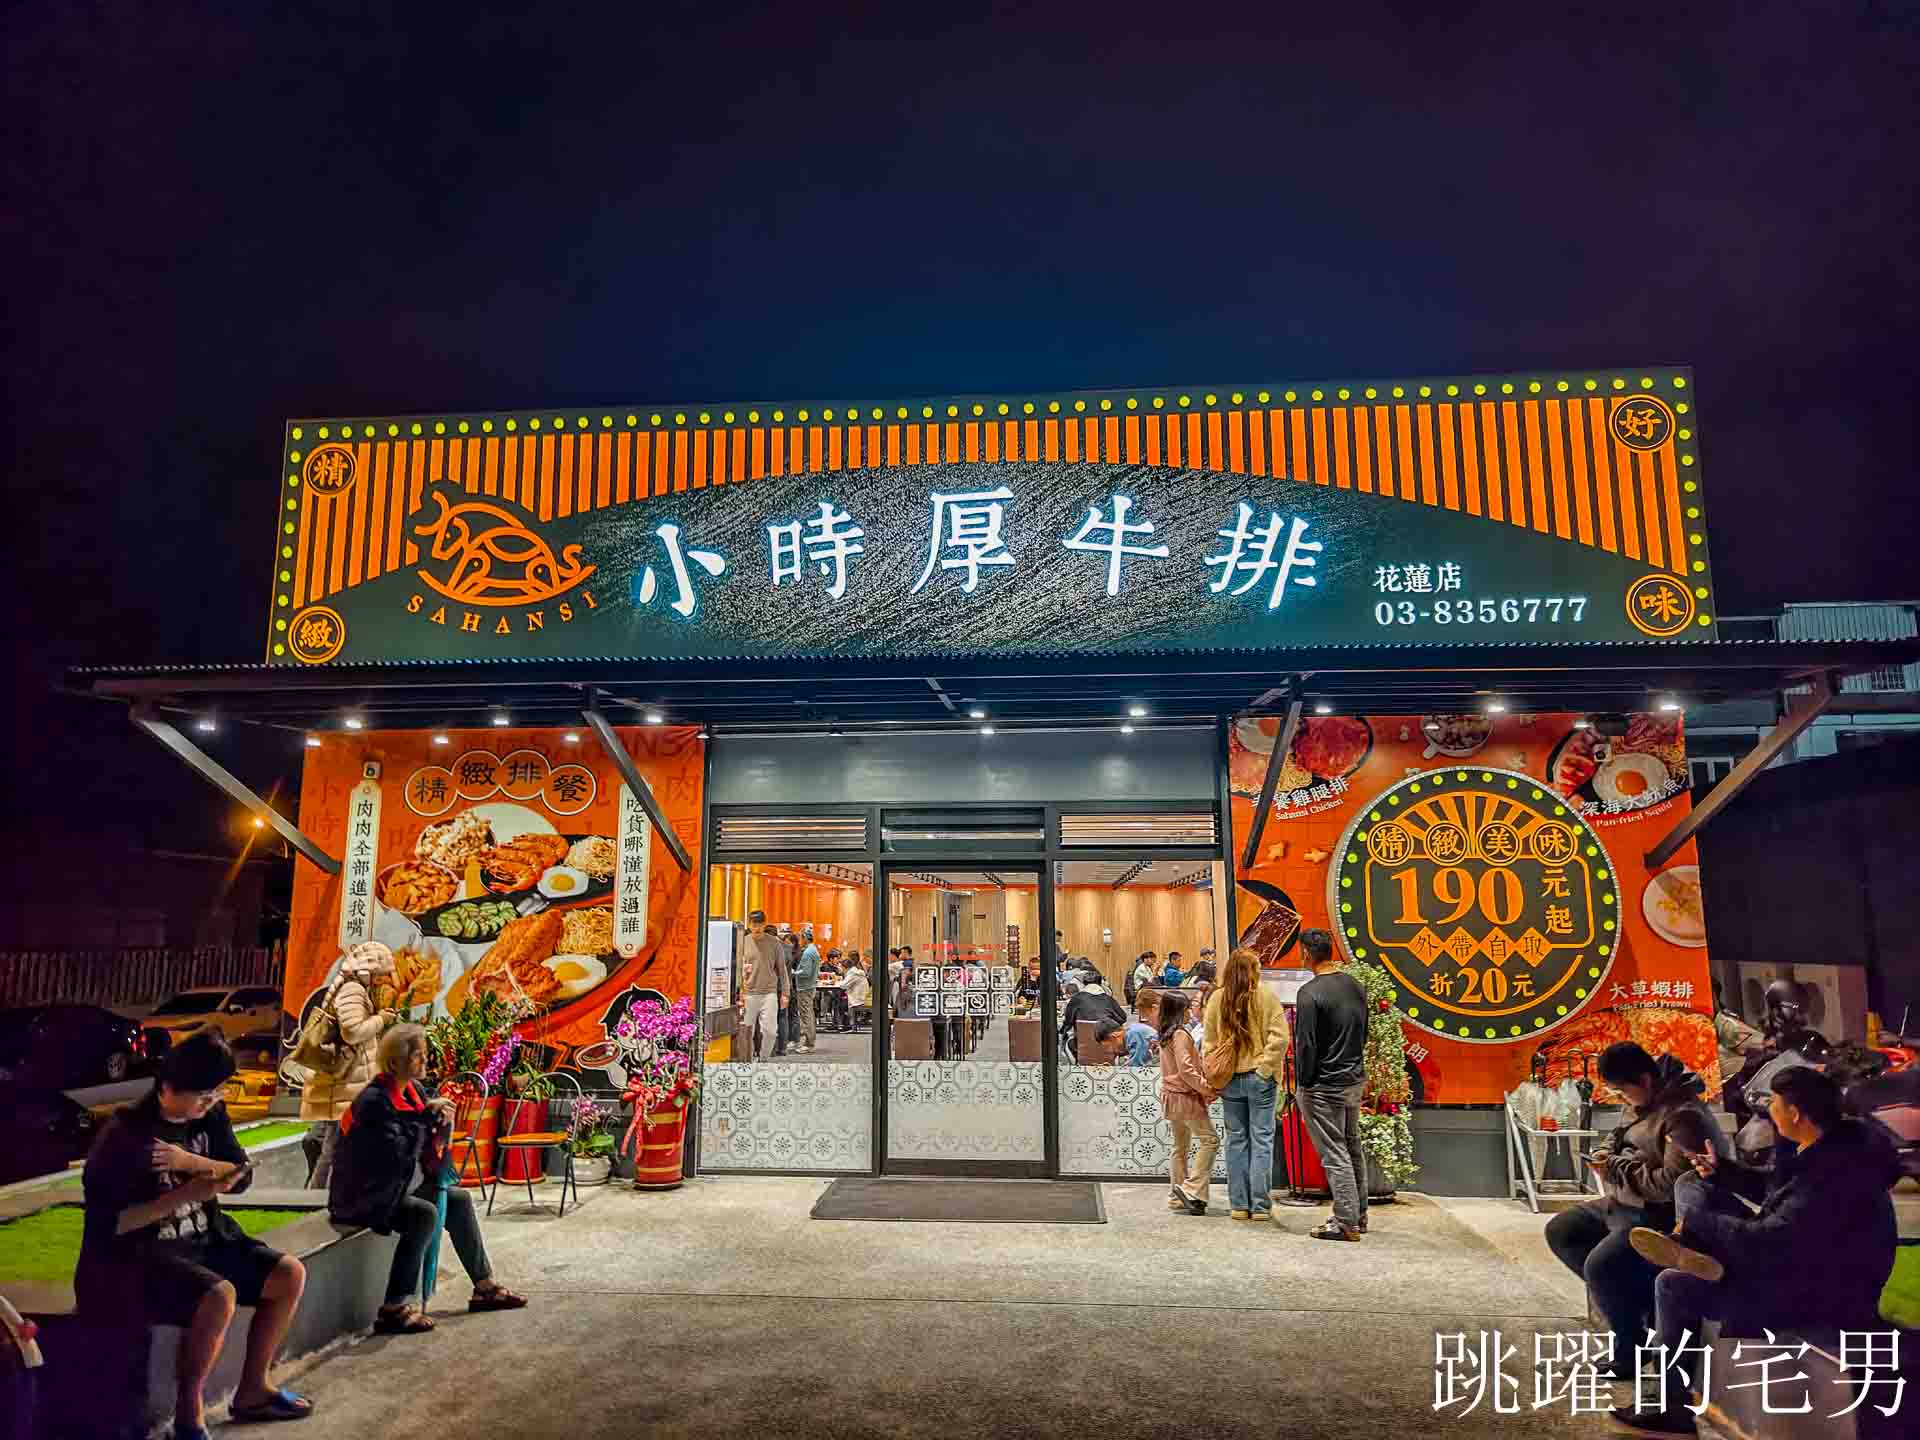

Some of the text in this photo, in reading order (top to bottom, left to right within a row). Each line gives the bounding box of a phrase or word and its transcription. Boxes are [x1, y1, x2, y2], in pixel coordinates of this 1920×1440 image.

[1619, 408, 1662, 440] 好
[639, 487, 1322, 616] 小時厚牛排
[1372, 562, 1462, 593] 花蓮店
[407, 591, 597, 634] SAHANSI
[1375, 597, 1588, 626] 03-8356777
[1629, 586, 1684, 623] 味
[414, 759, 588, 804] 精緻排餐
[1310, 798, 1344, 814] Chicken
[1375, 828, 1571, 858] 精緻美味
[346, 800, 374, 938] 肉肉全部進我嘴
[620, 798, 645, 935] 吃貨哪懂放過誰
[1391, 867, 1524, 925] 190
[1415, 934, 1543, 959] 外帶自取
[1609, 980, 1696, 1001] 大草蝦排
